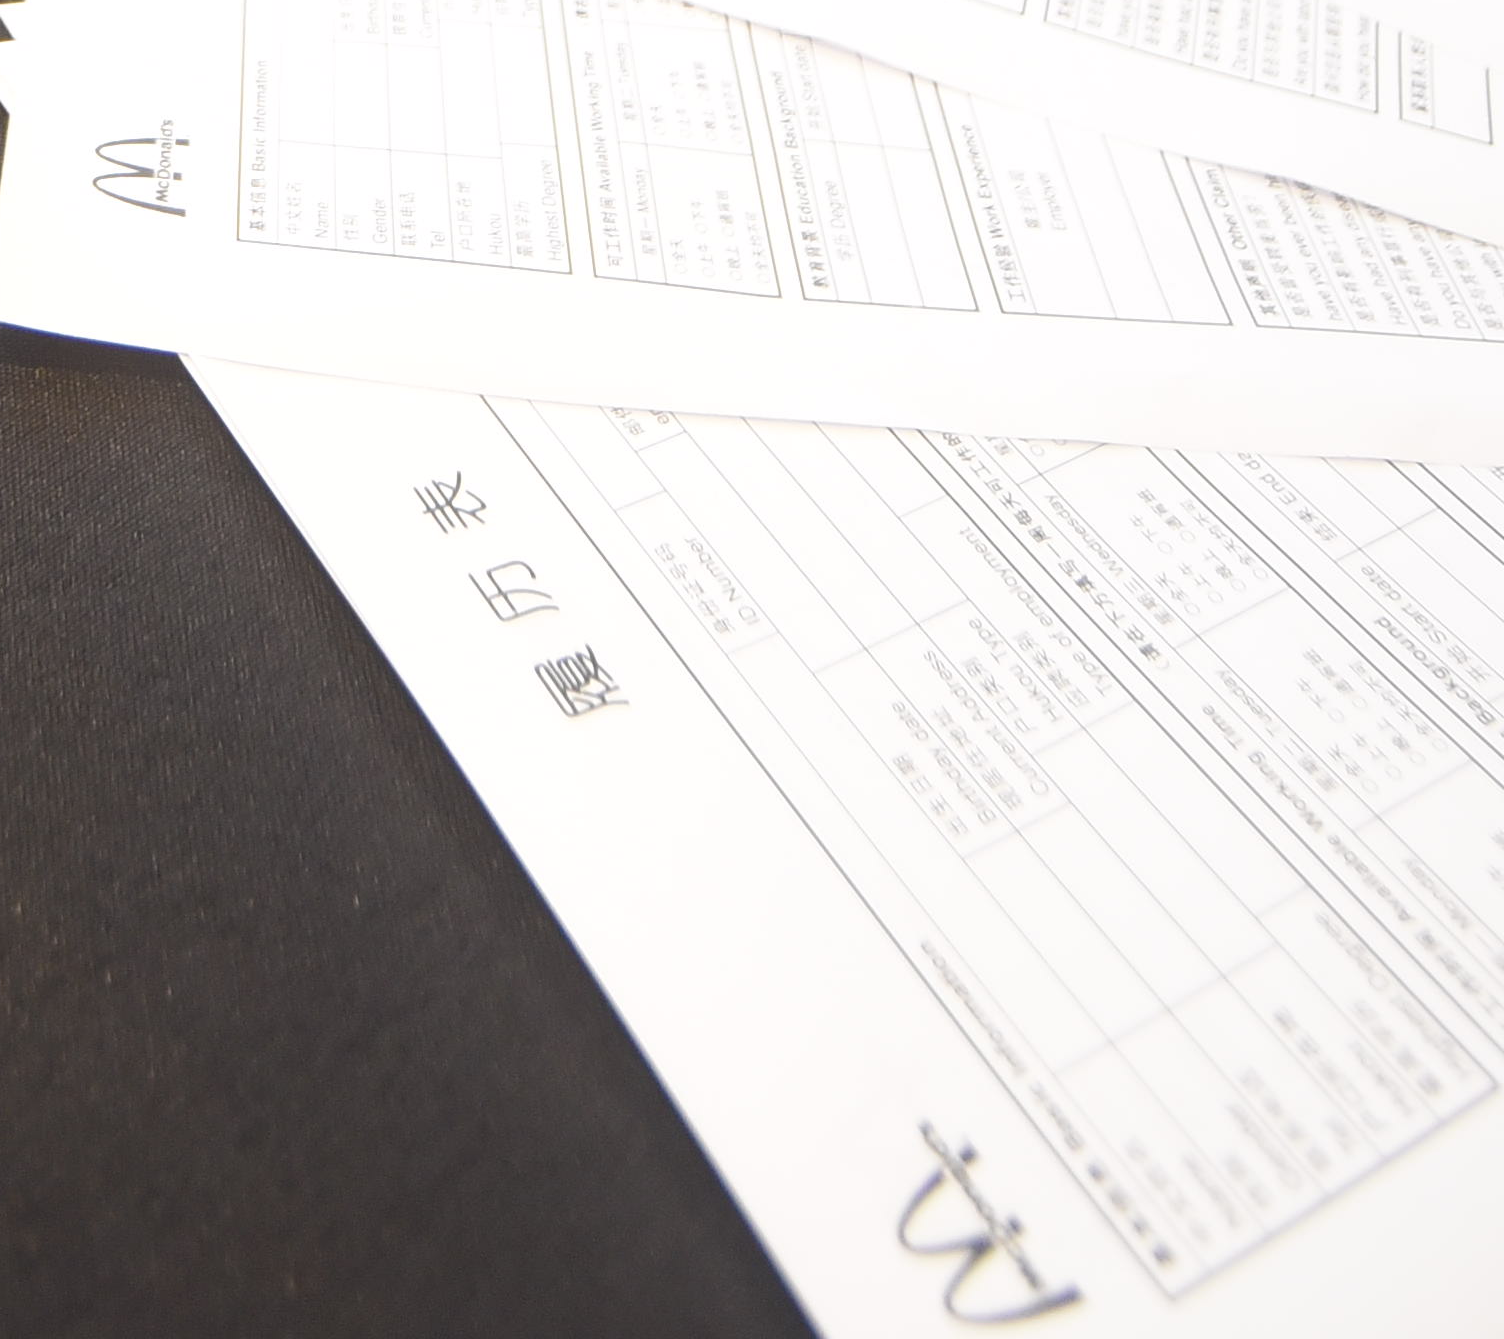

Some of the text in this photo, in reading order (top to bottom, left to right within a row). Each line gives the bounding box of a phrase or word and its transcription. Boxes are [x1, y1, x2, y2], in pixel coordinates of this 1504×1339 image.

[252, 60, 269, 133] Information
[588, 81, 604, 132] Working
[156, 118, 175, 204] McDonald's
[250, 137, 267, 172] Basic
[593, 135, 613, 193] Available
[770, 70, 815, 225] Education Background
[960, 124, 993, 200] Experience
[313, 201, 330, 239] Name
[370, 197, 388, 244] Gender
[540, 158, 565, 261] Highest Degree
[635, 168, 649, 214] Monday
[824, 180, 847, 229] Degree
[981, 203, 1005, 240] Work
[1037, 171, 1068, 232] Employer
[1205, 167, 1231, 209] Claim
[429, 230, 446, 249] Tel
[487, 213, 504, 256] Hukou
[1223, 212, 1249, 251] Other
[1418, 245, 1444, 279] have
[1364, 262, 1388, 288] had
[1379, 290, 1409, 326] Have
[1258, 472, 1338, 542] 结束 End
[653, 542, 737, 635] 身份证号码
[683, 537, 765, 627] ID Number
[1044, 494, 1176, 626] 星期三 Wednesday
[1129, 514, 1213, 588] 上午 下午
[1153, 571, 1189, 603] 全天
[413, 469, 630, 717] 履历表
[959, 525, 1113, 698] Type of employment
[1360, 564, 1493, 684] 开始 Start date
[961, 656, 1038, 735] 户口类别
[968, 617, 1064, 724] Hukou Type
[1013, 630, 1091, 709] 应聘类别
[1215, 664, 1285, 740] Tuesday
[1372, 613, 1500, 728] Background
[922, 649, 1051, 797] Current Address
[1201, 704, 1244, 752] Time
[1296, 677, 1390, 762] 上午 下午
[891, 700, 1003, 827] Birthday date
[891, 752, 971, 839] 出生日期
[931, 704, 1025, 812] 现居住地址
[1247, 749, 1325, 834] Working
[1326, 742, 1366, 780] 全天
[1326, 834, 1417, 924] Available
[1401, 852, 1475, 932] Monday
[1315, 912, 1391, 992] Degree
[919, 938, 1029, 1079] Information
